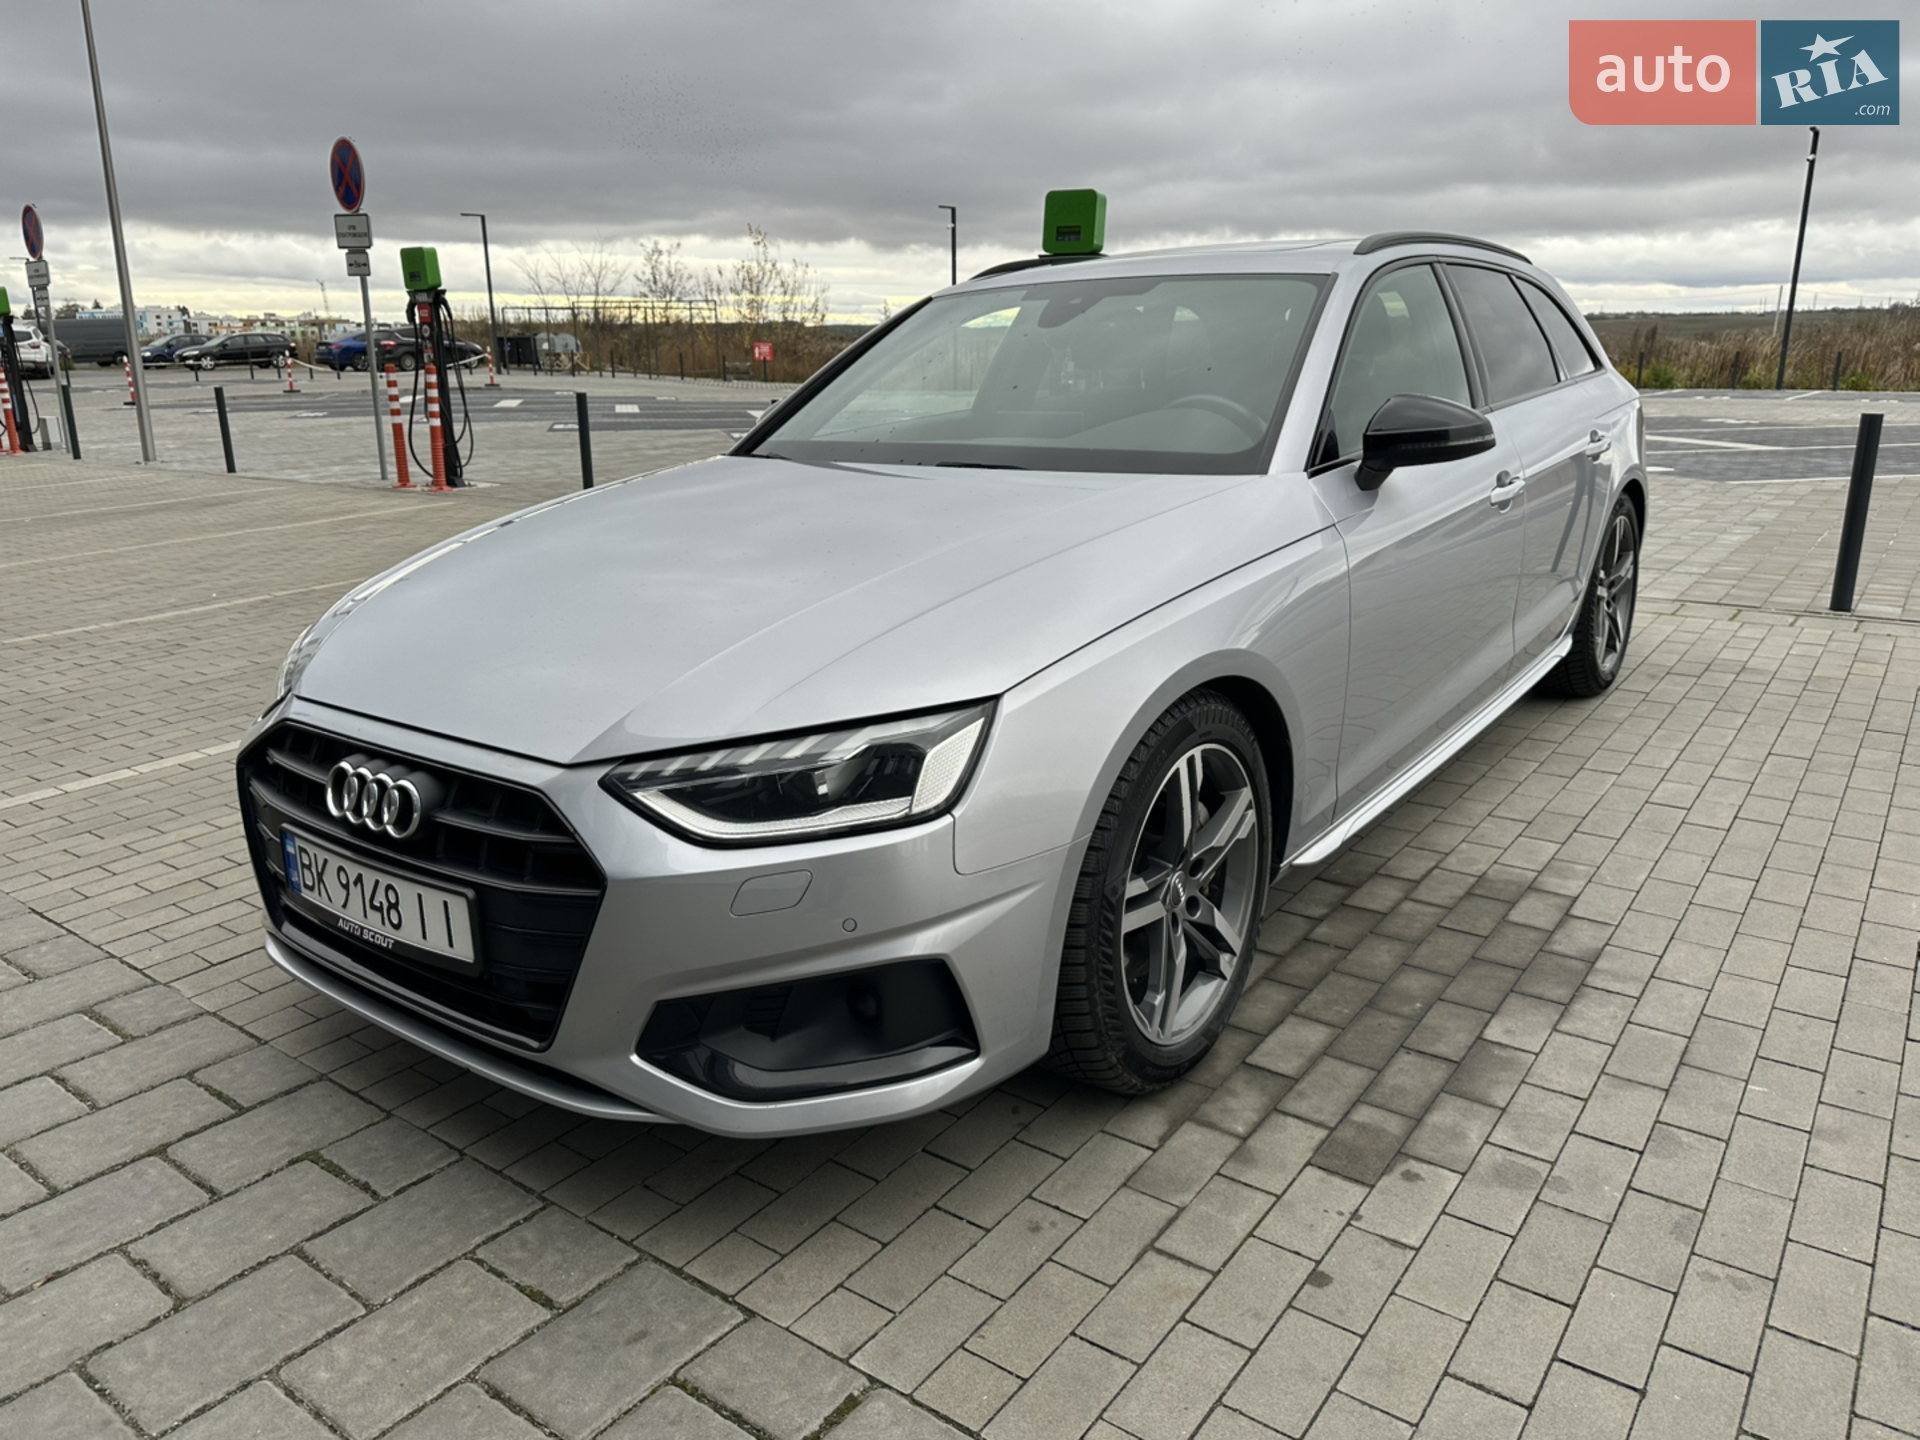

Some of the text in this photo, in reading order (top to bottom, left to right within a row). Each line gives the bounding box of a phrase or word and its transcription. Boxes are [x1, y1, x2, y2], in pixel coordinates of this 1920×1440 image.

[298, 845, 456, 949] BK 9148 II
[337, 918, 395, 950] AUTO SCOUT
